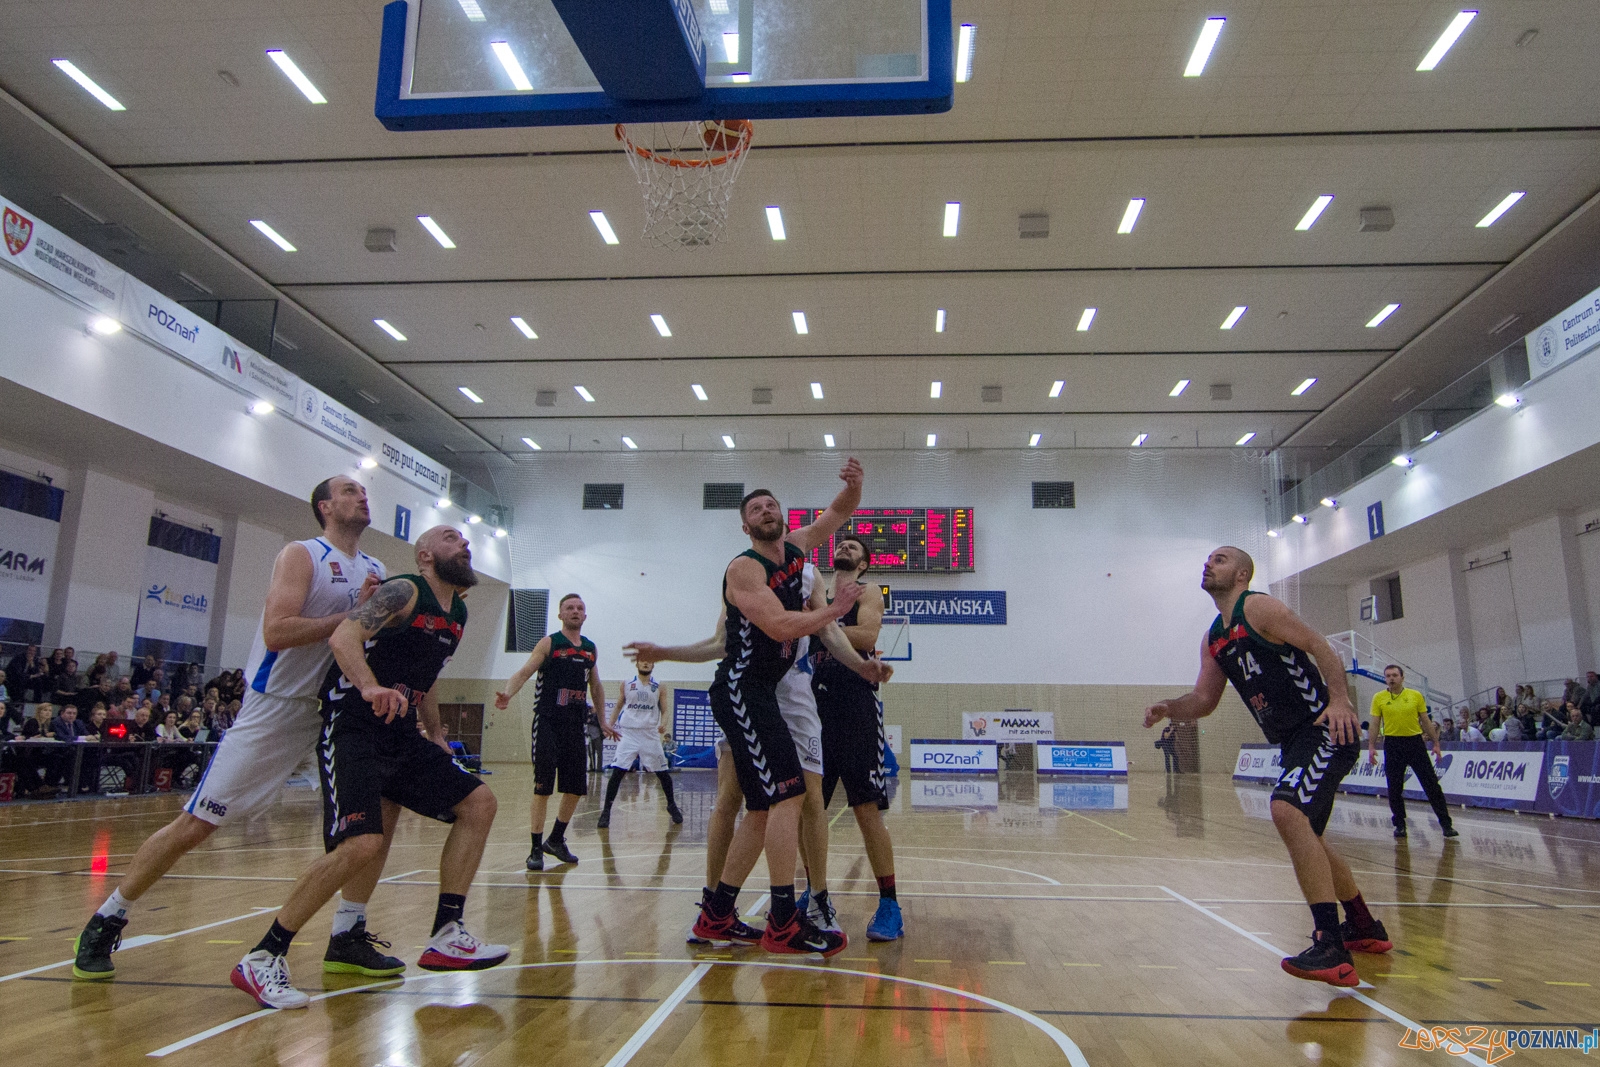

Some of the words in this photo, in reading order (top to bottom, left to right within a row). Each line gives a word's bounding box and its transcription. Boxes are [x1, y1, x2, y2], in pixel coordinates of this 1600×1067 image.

[1562, 307, 1594, 331] Centrum
[322, 401, 343, 419] Centrum
[382, 442, 448, 491] cspp.put.poznan.pl
[399, 511, 406, 537] 1
[857, 523, 873, 534] 52
[891, 523, 907, 534] 43
[1372, 507, 1379, 535] 1
[0, 550, 45, 575] ARM
[893, 596, 994, 615] POZNAŃSKA
[1238, 651, 1262, 681] 24
[1001, 718, 1040, 728] MAXXX
[808, 736, 820, 757] 8
[1464, 760, 1527, 781] BIOFARM
[206, 800, 227, 817] PBG
